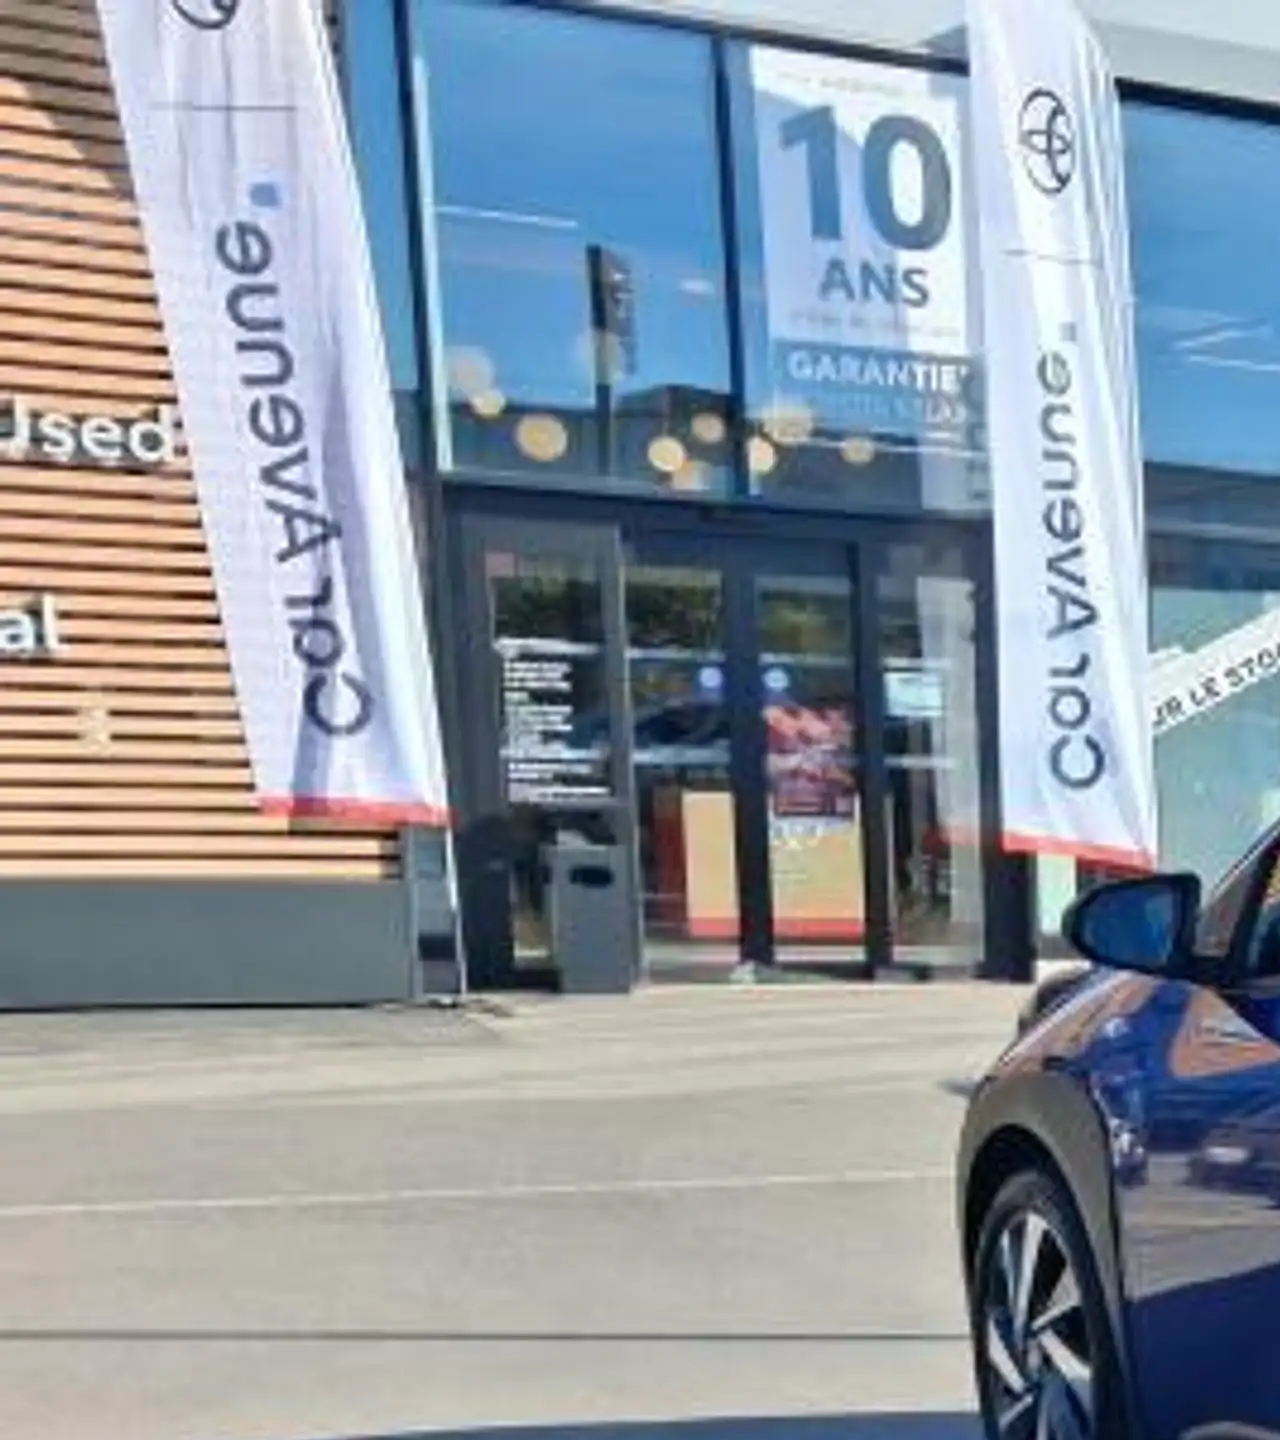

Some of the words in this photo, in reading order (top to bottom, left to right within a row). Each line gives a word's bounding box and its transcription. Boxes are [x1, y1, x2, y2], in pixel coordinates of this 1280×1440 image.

[777, 105, 952, 251] 10
[819, 257, 931, 308] ANS
[1189, 676, 1221, 708] LE
